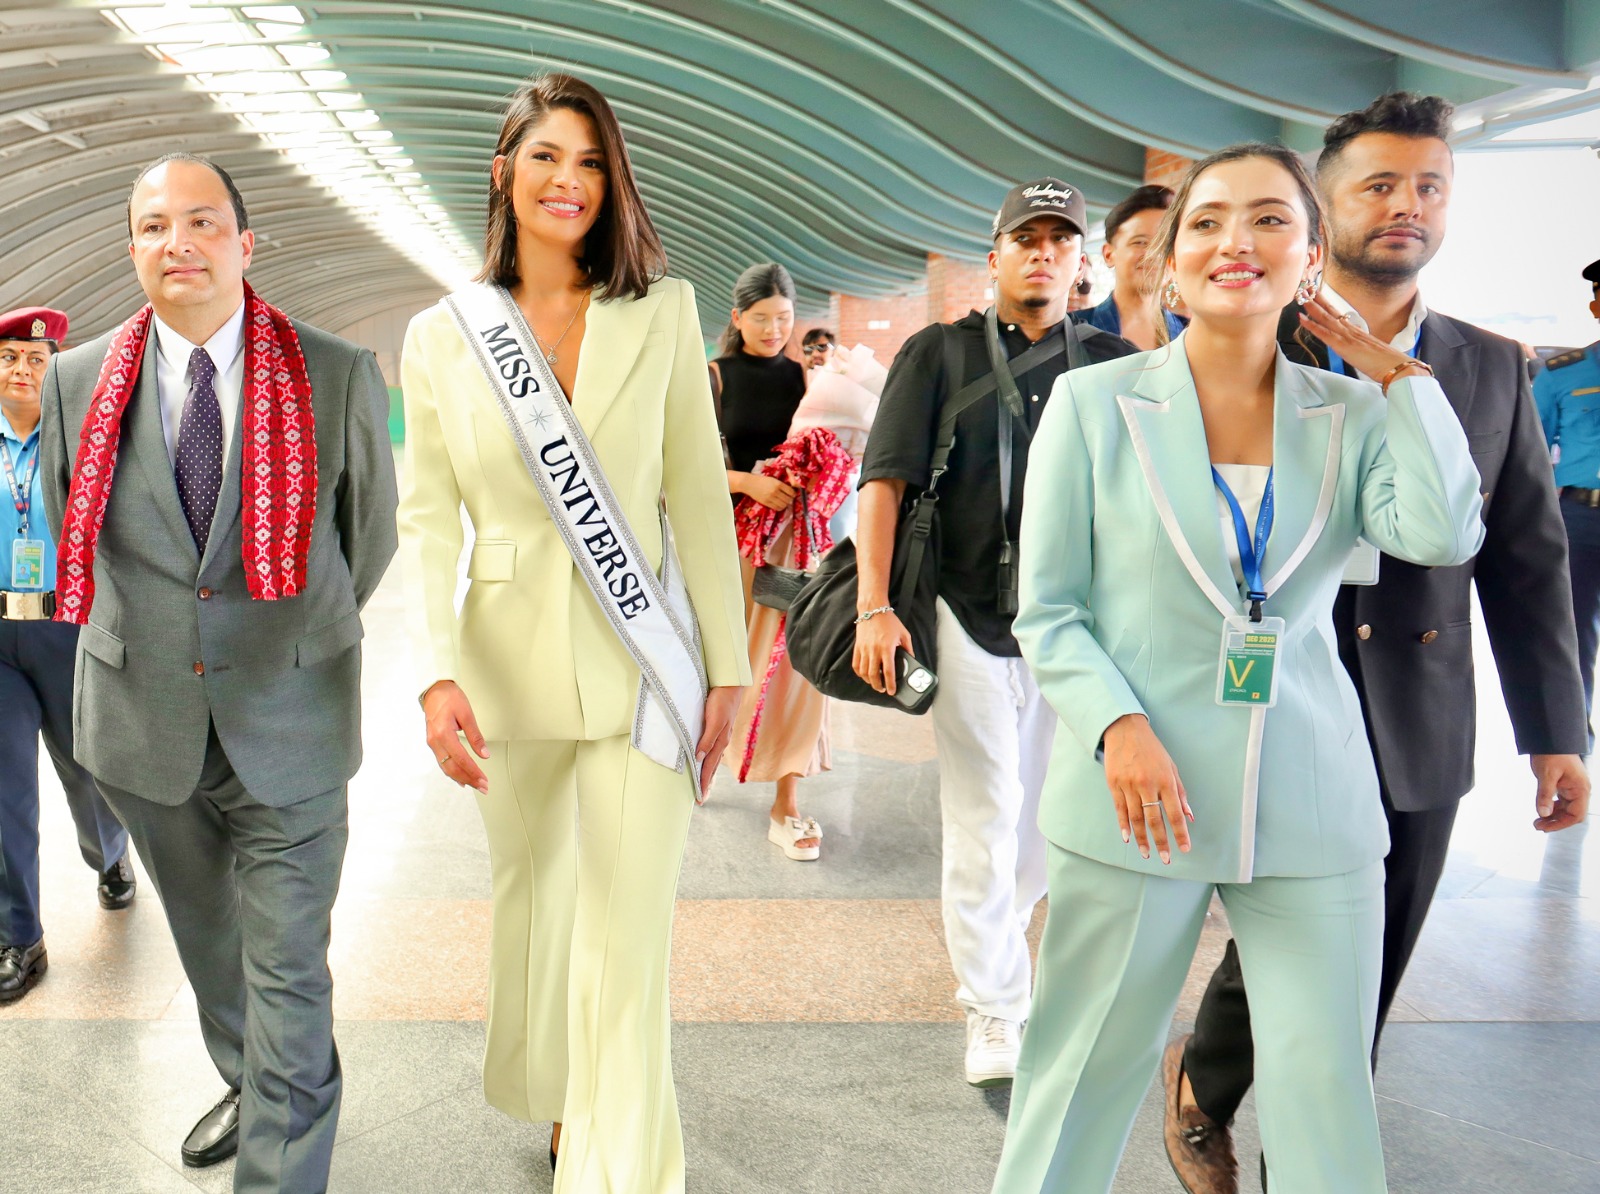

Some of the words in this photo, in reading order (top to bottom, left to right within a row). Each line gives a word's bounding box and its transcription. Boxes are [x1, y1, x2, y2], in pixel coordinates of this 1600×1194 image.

[479, 321, 541, 399] MISS
[540, 434, 651, 621] UNIVERSE
[1227, 659, 1255, 688] V
